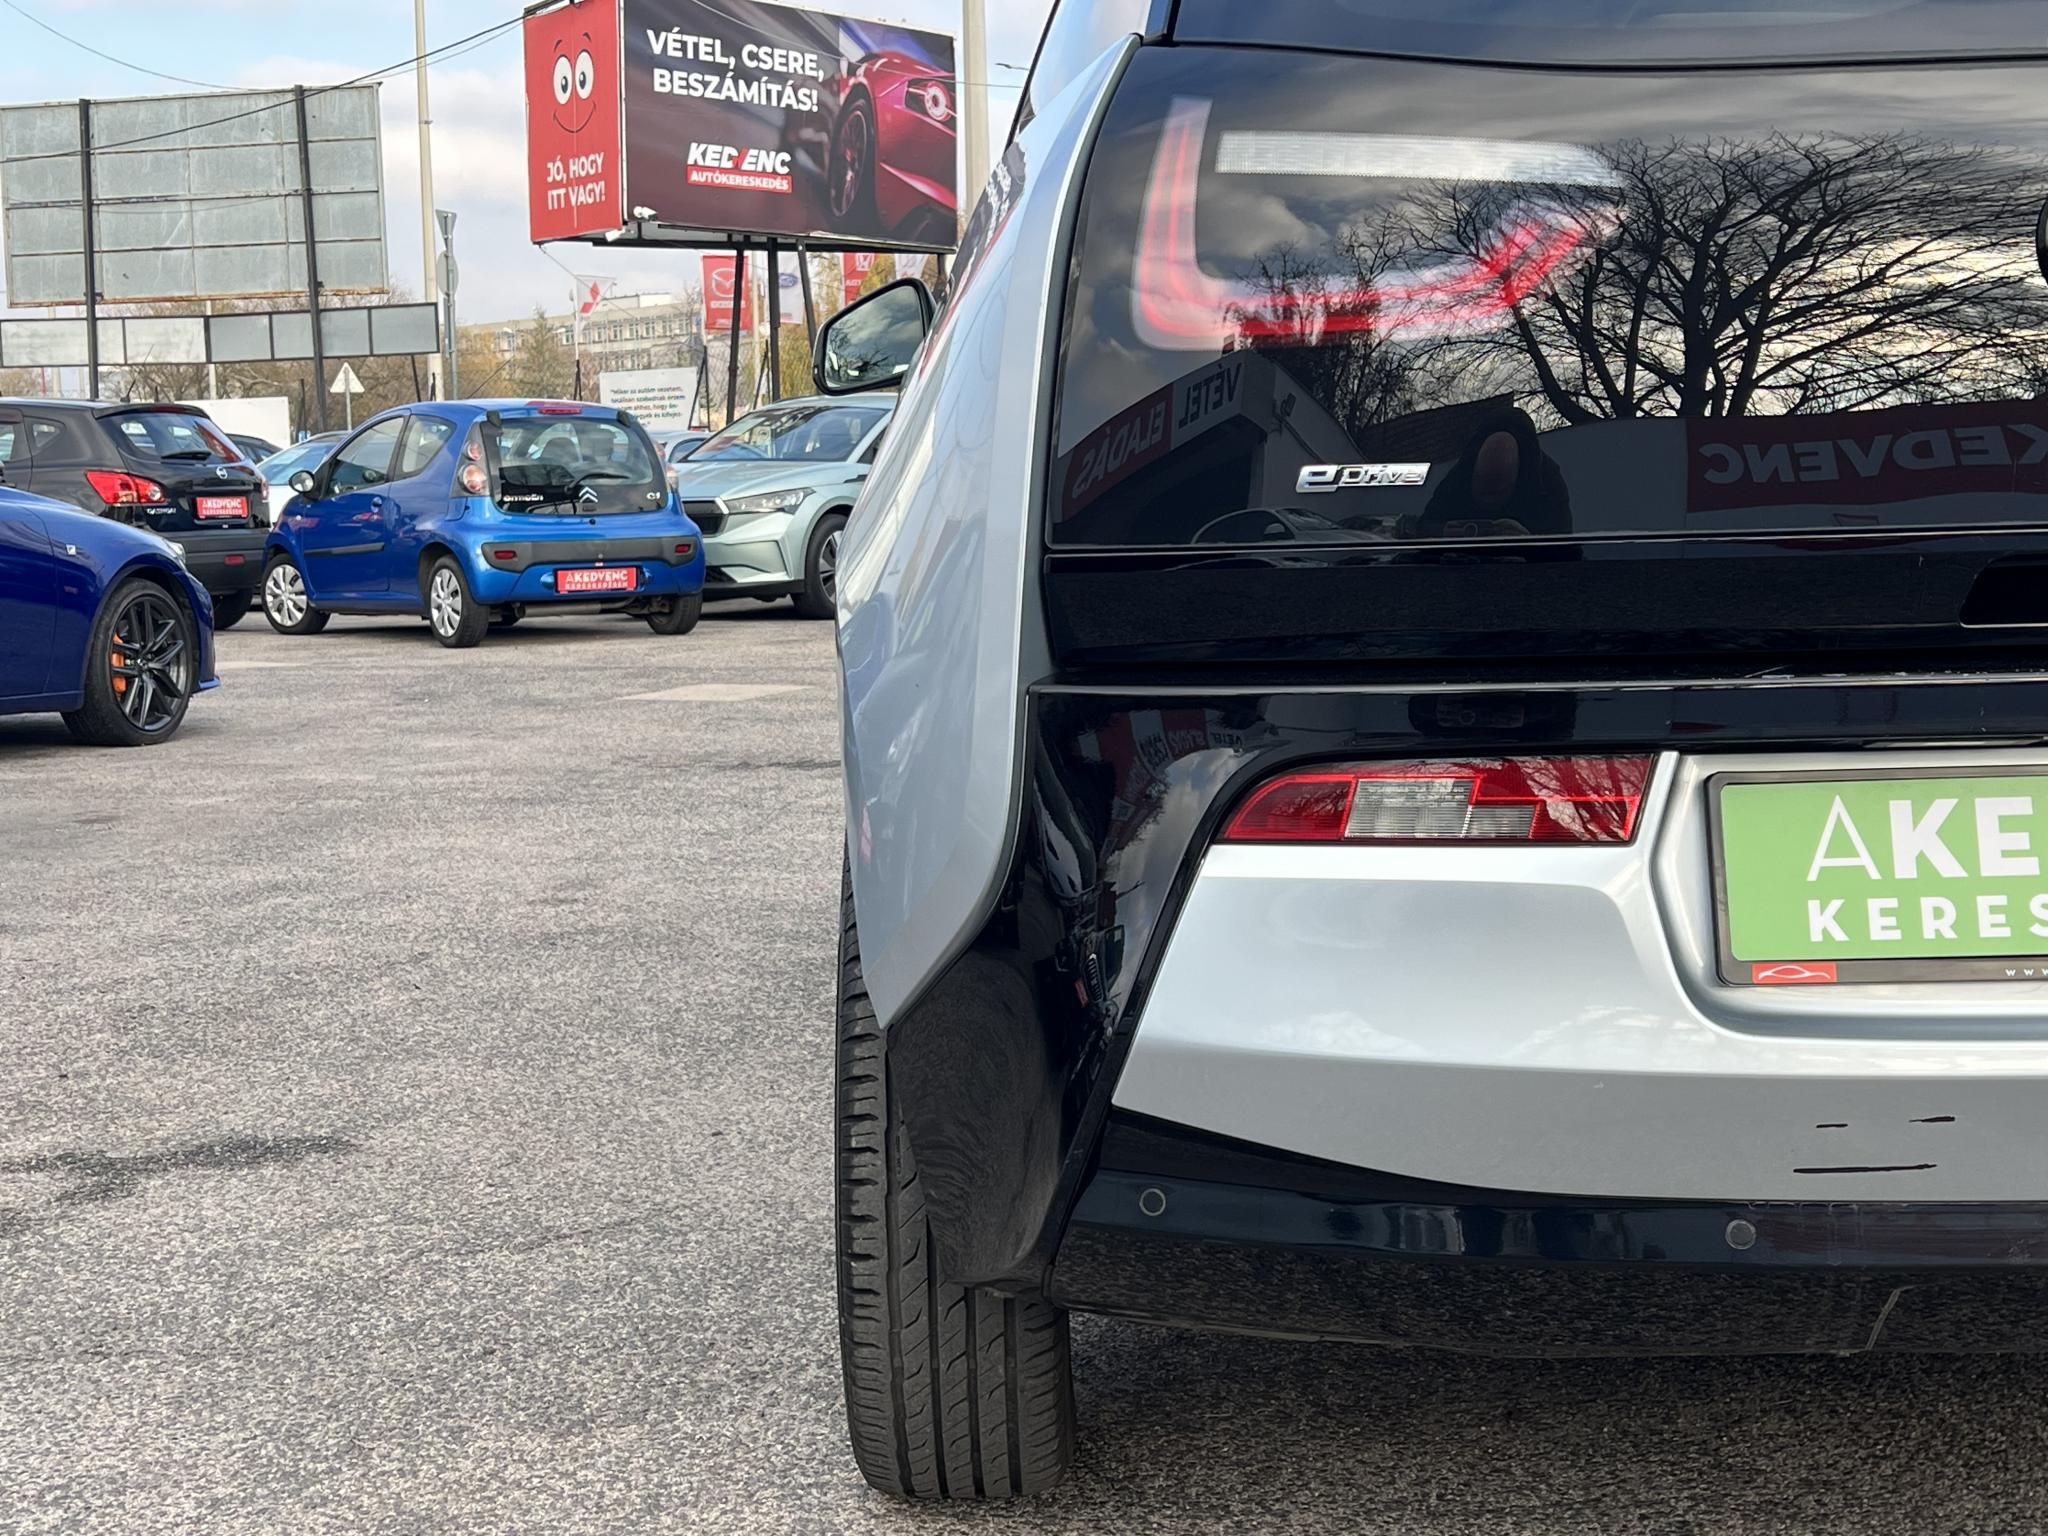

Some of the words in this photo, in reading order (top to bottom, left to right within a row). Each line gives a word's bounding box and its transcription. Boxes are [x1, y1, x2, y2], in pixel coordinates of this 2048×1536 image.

[646, 27, 735, 69] VÉTEL,
[742, 44, 824, 82] CSERE,
[653, 68, 818, 112] BESZÁMÍTÁS!
[547, 154, 566, 184] JÓ,
[569, 152, 604, 178] HOGY
[691, 171, 788, 190] AUTÓKERESKEDÉS
[548, 188, 566, 210] ITT
[568, 180, 606, 207] VAGY!
